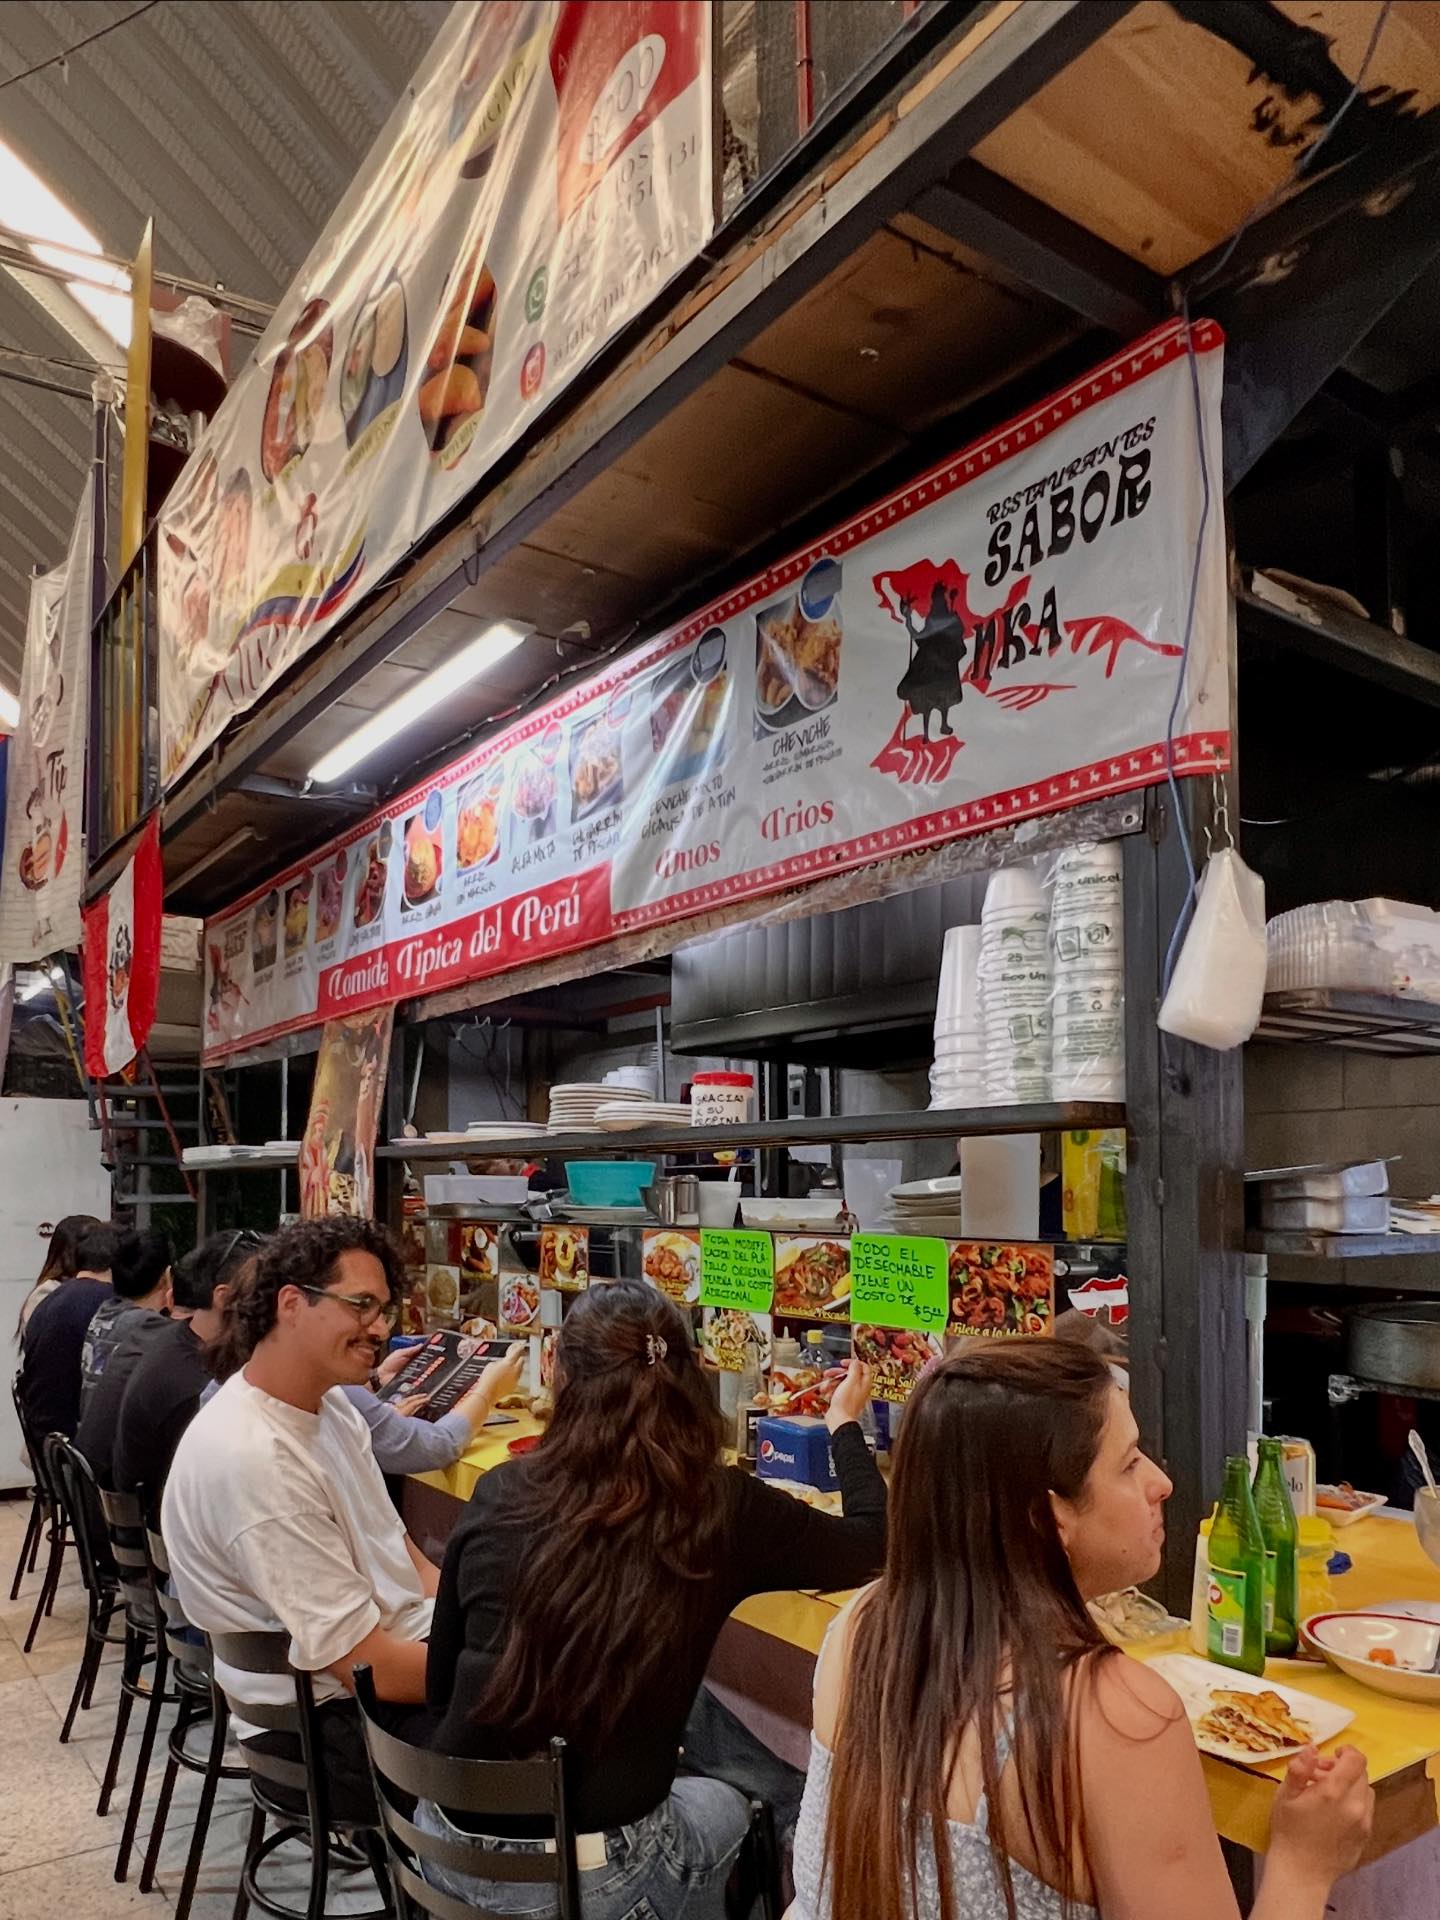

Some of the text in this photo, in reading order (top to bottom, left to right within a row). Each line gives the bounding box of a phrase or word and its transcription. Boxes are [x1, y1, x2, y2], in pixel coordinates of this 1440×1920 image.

[986, 416, 1156, 525] RESTAURANTES
[984, 448, 1152, 587] SABOR
[760, 798, 835, 843] Trios
[655, 839, 722, 881] Duos
[328, 950, 390, 1001] Comida
[469, 905, 502, 959] del
[511, 880, 581, 942] Perú
[854, 1241, 919, 1262] TODO EL
[854, 1256, 937, 1280] DESECHABLE
[853, 1273, 915, 1293] TIENE UN
[854, 1288, 916, 1306] COSTO DE
[953, 1321, 981, 1336] Filete
[982, 1328, 991, 1337] a
